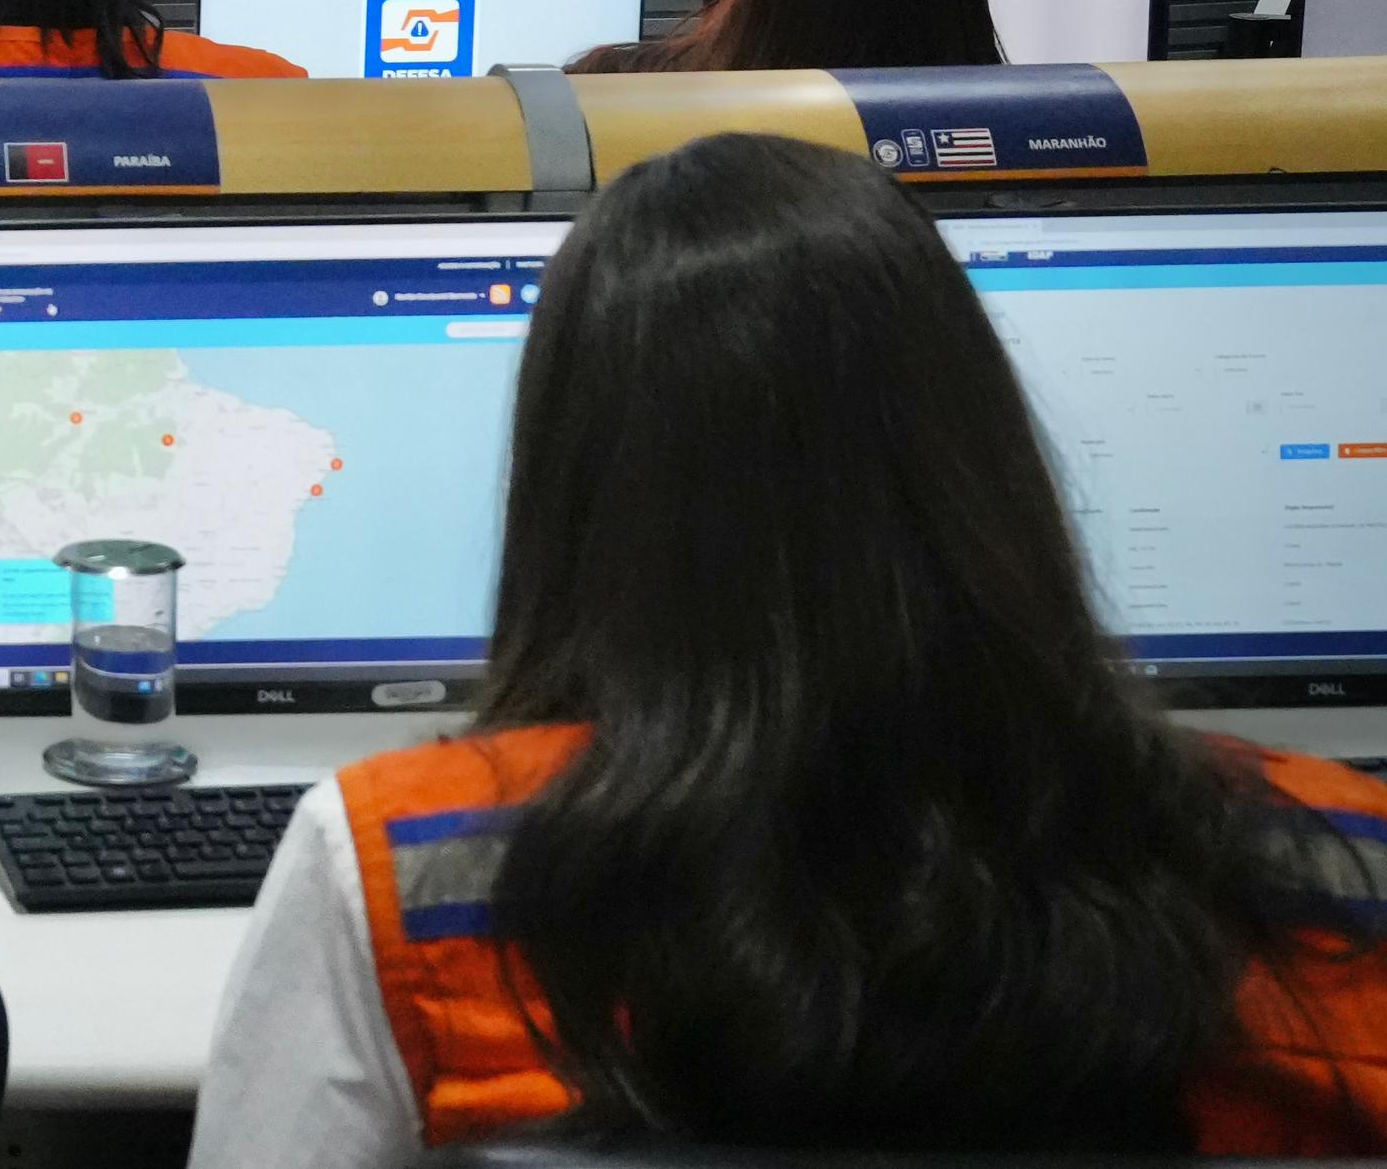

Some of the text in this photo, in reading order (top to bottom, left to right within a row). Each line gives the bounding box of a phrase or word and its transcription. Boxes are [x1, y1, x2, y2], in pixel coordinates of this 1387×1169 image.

[1028, 135, 1107, 151] MARANHÃO
[113, 153, 171, 167] PARAÍBA
[257, 688, 295, 703] DELL
